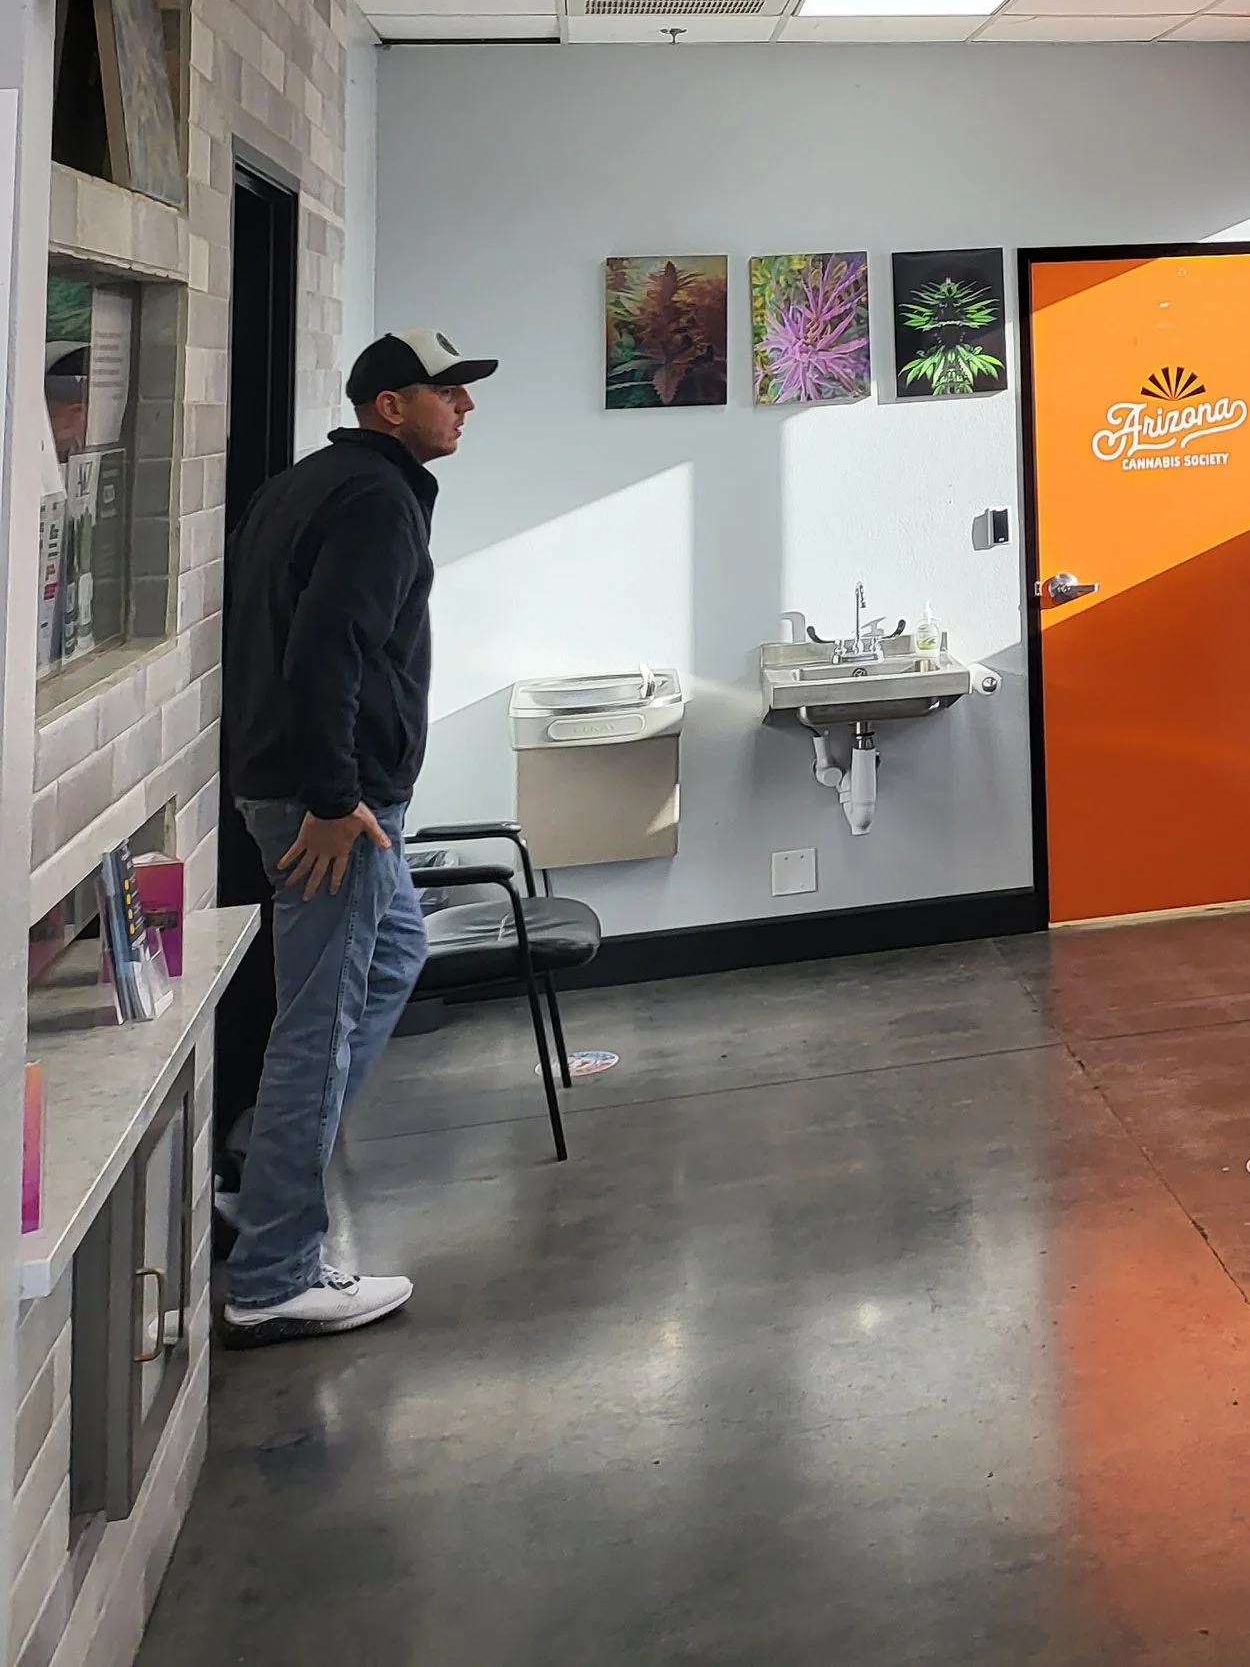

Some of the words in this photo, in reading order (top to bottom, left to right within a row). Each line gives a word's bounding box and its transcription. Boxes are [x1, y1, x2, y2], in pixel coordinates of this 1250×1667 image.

[1092, 398, 1247, 461] Arizona
[1122, 454, 1181, 470] CANNABIS
[1184, 452, 1229, 467] SOCIETY
